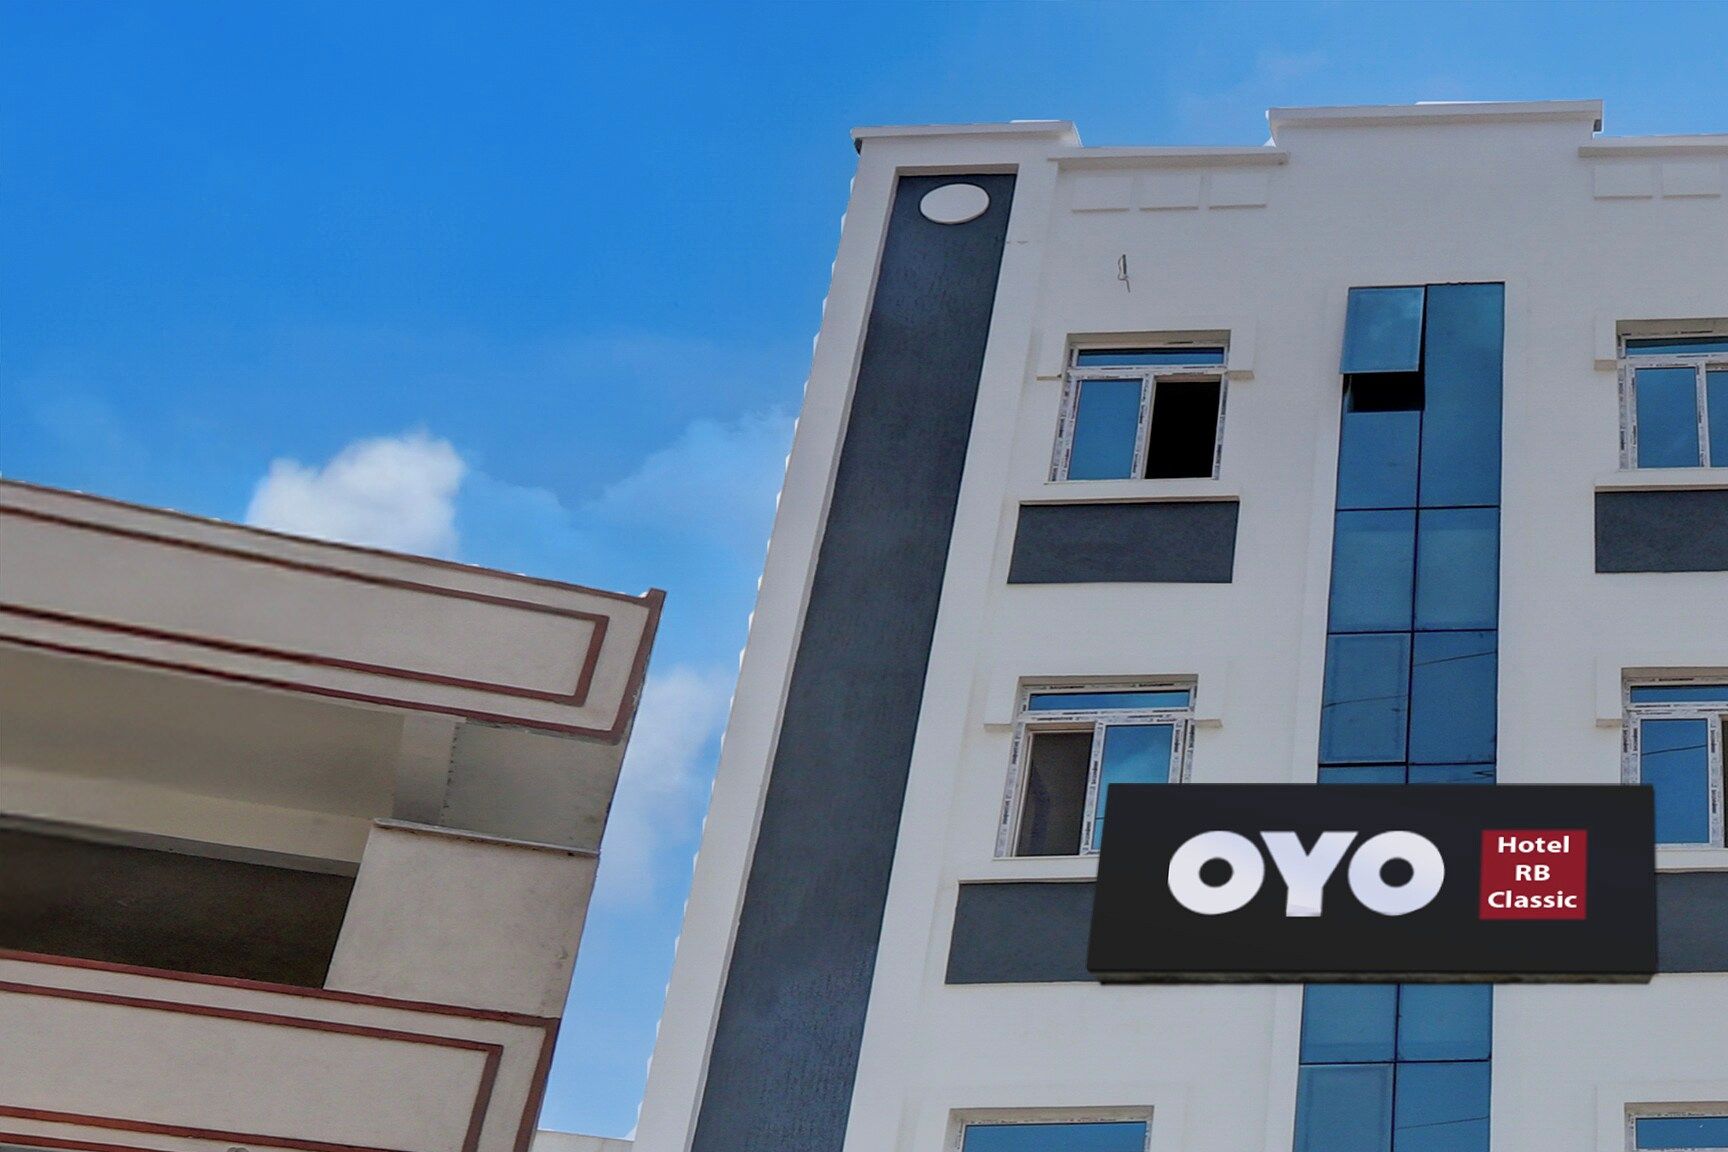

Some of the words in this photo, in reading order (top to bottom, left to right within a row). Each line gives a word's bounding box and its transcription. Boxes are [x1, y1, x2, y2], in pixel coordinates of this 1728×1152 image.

[1498, 836, 1570, 854] Hotel
[1167, 830, 1445, 917] OYO
[1515, 865, 1551, 881] RB
[1487, 890, 1578, 909] Classic
